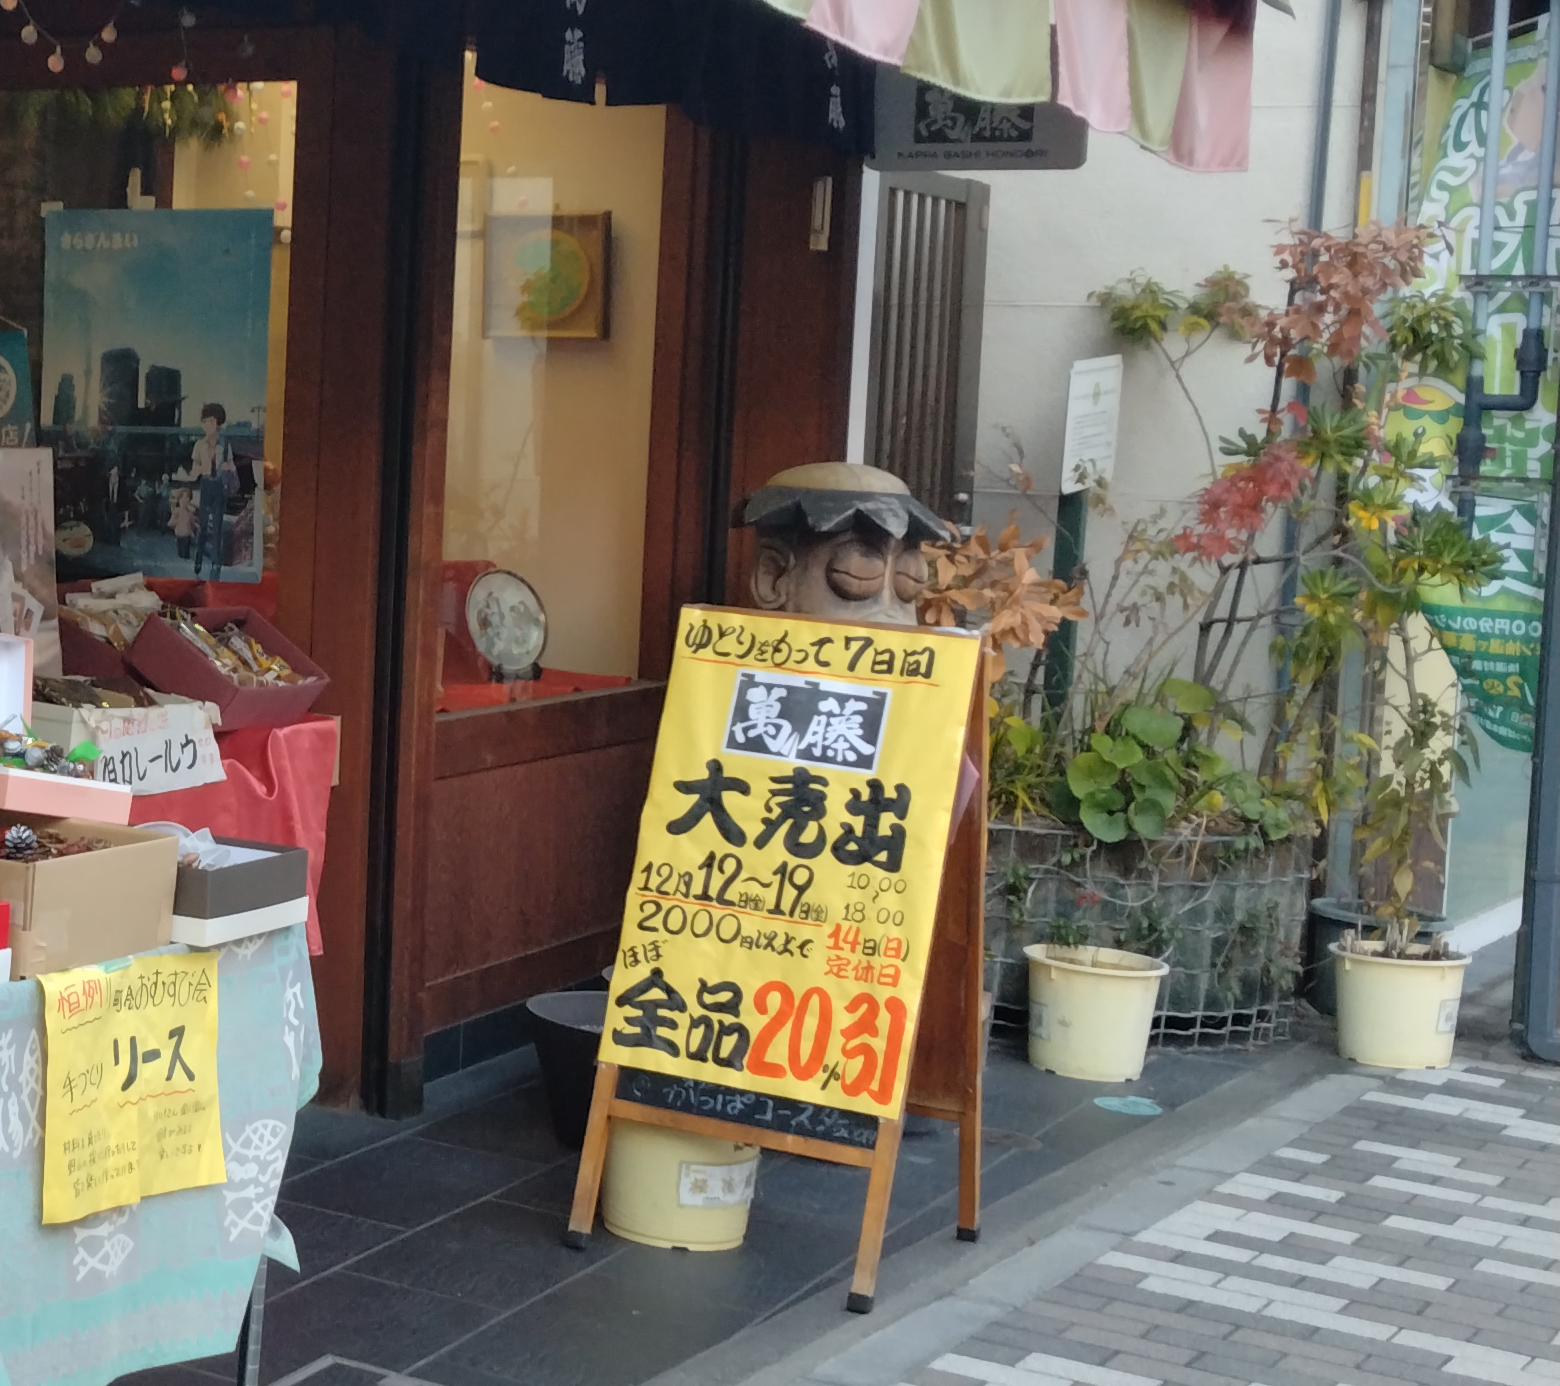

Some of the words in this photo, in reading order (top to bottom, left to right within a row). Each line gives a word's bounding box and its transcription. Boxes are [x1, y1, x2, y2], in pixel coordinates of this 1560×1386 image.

[731, 684, 876, 762] 萬藤
[622, 940, 668, 969] ほぼ
[824, 954, 901, 988] 定休日
[61, 1063, 104, 1104] 手づくり
[113, 1024, 196, 1093] リース
